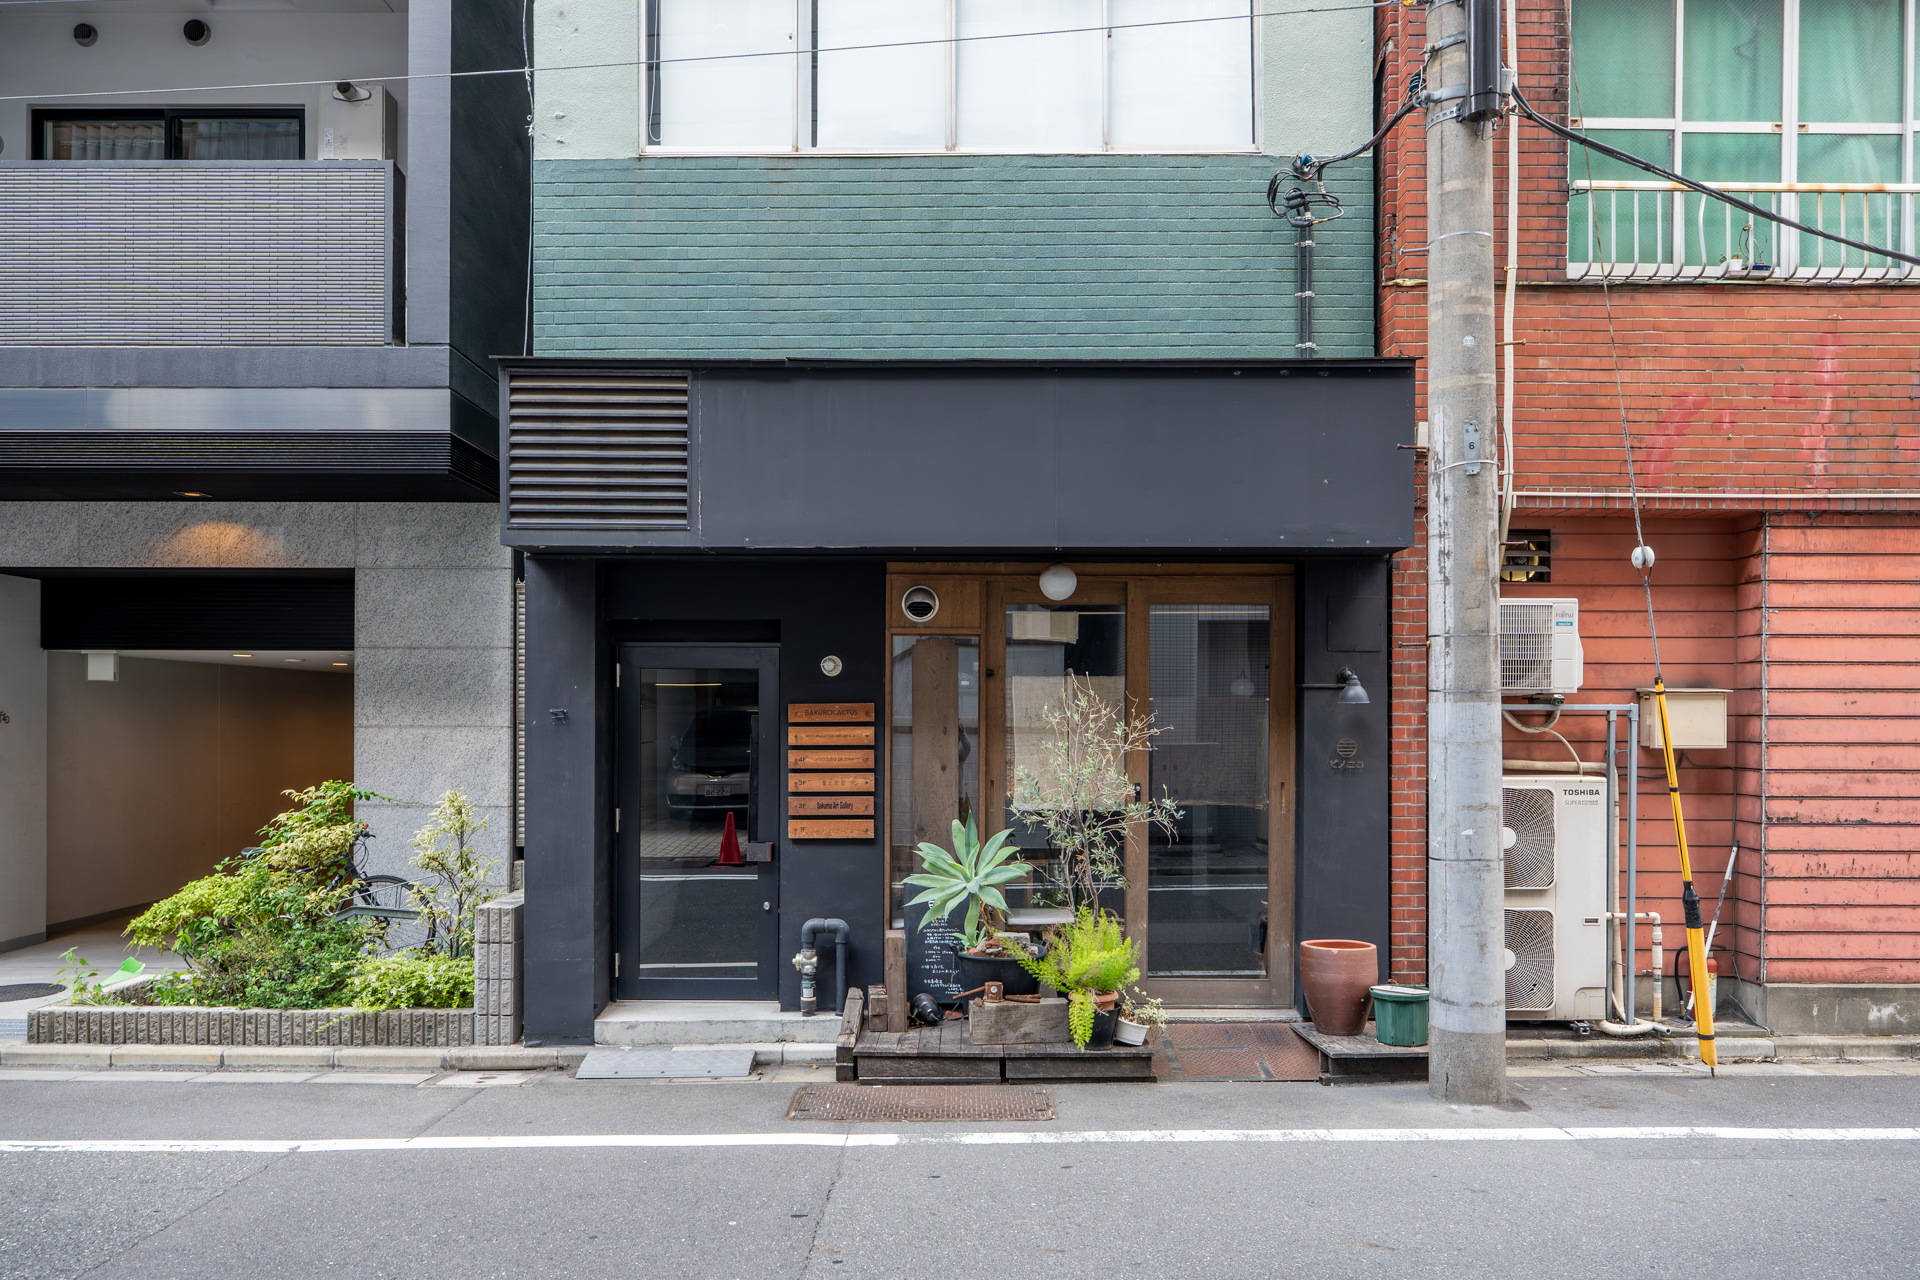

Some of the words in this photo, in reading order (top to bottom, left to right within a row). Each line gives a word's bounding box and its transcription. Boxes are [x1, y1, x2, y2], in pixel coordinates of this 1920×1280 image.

[1468, 441, 1475, 450] 6
[816, 801, 832, 810] Sakuma
[840, 801, 854, 811] Gallery
